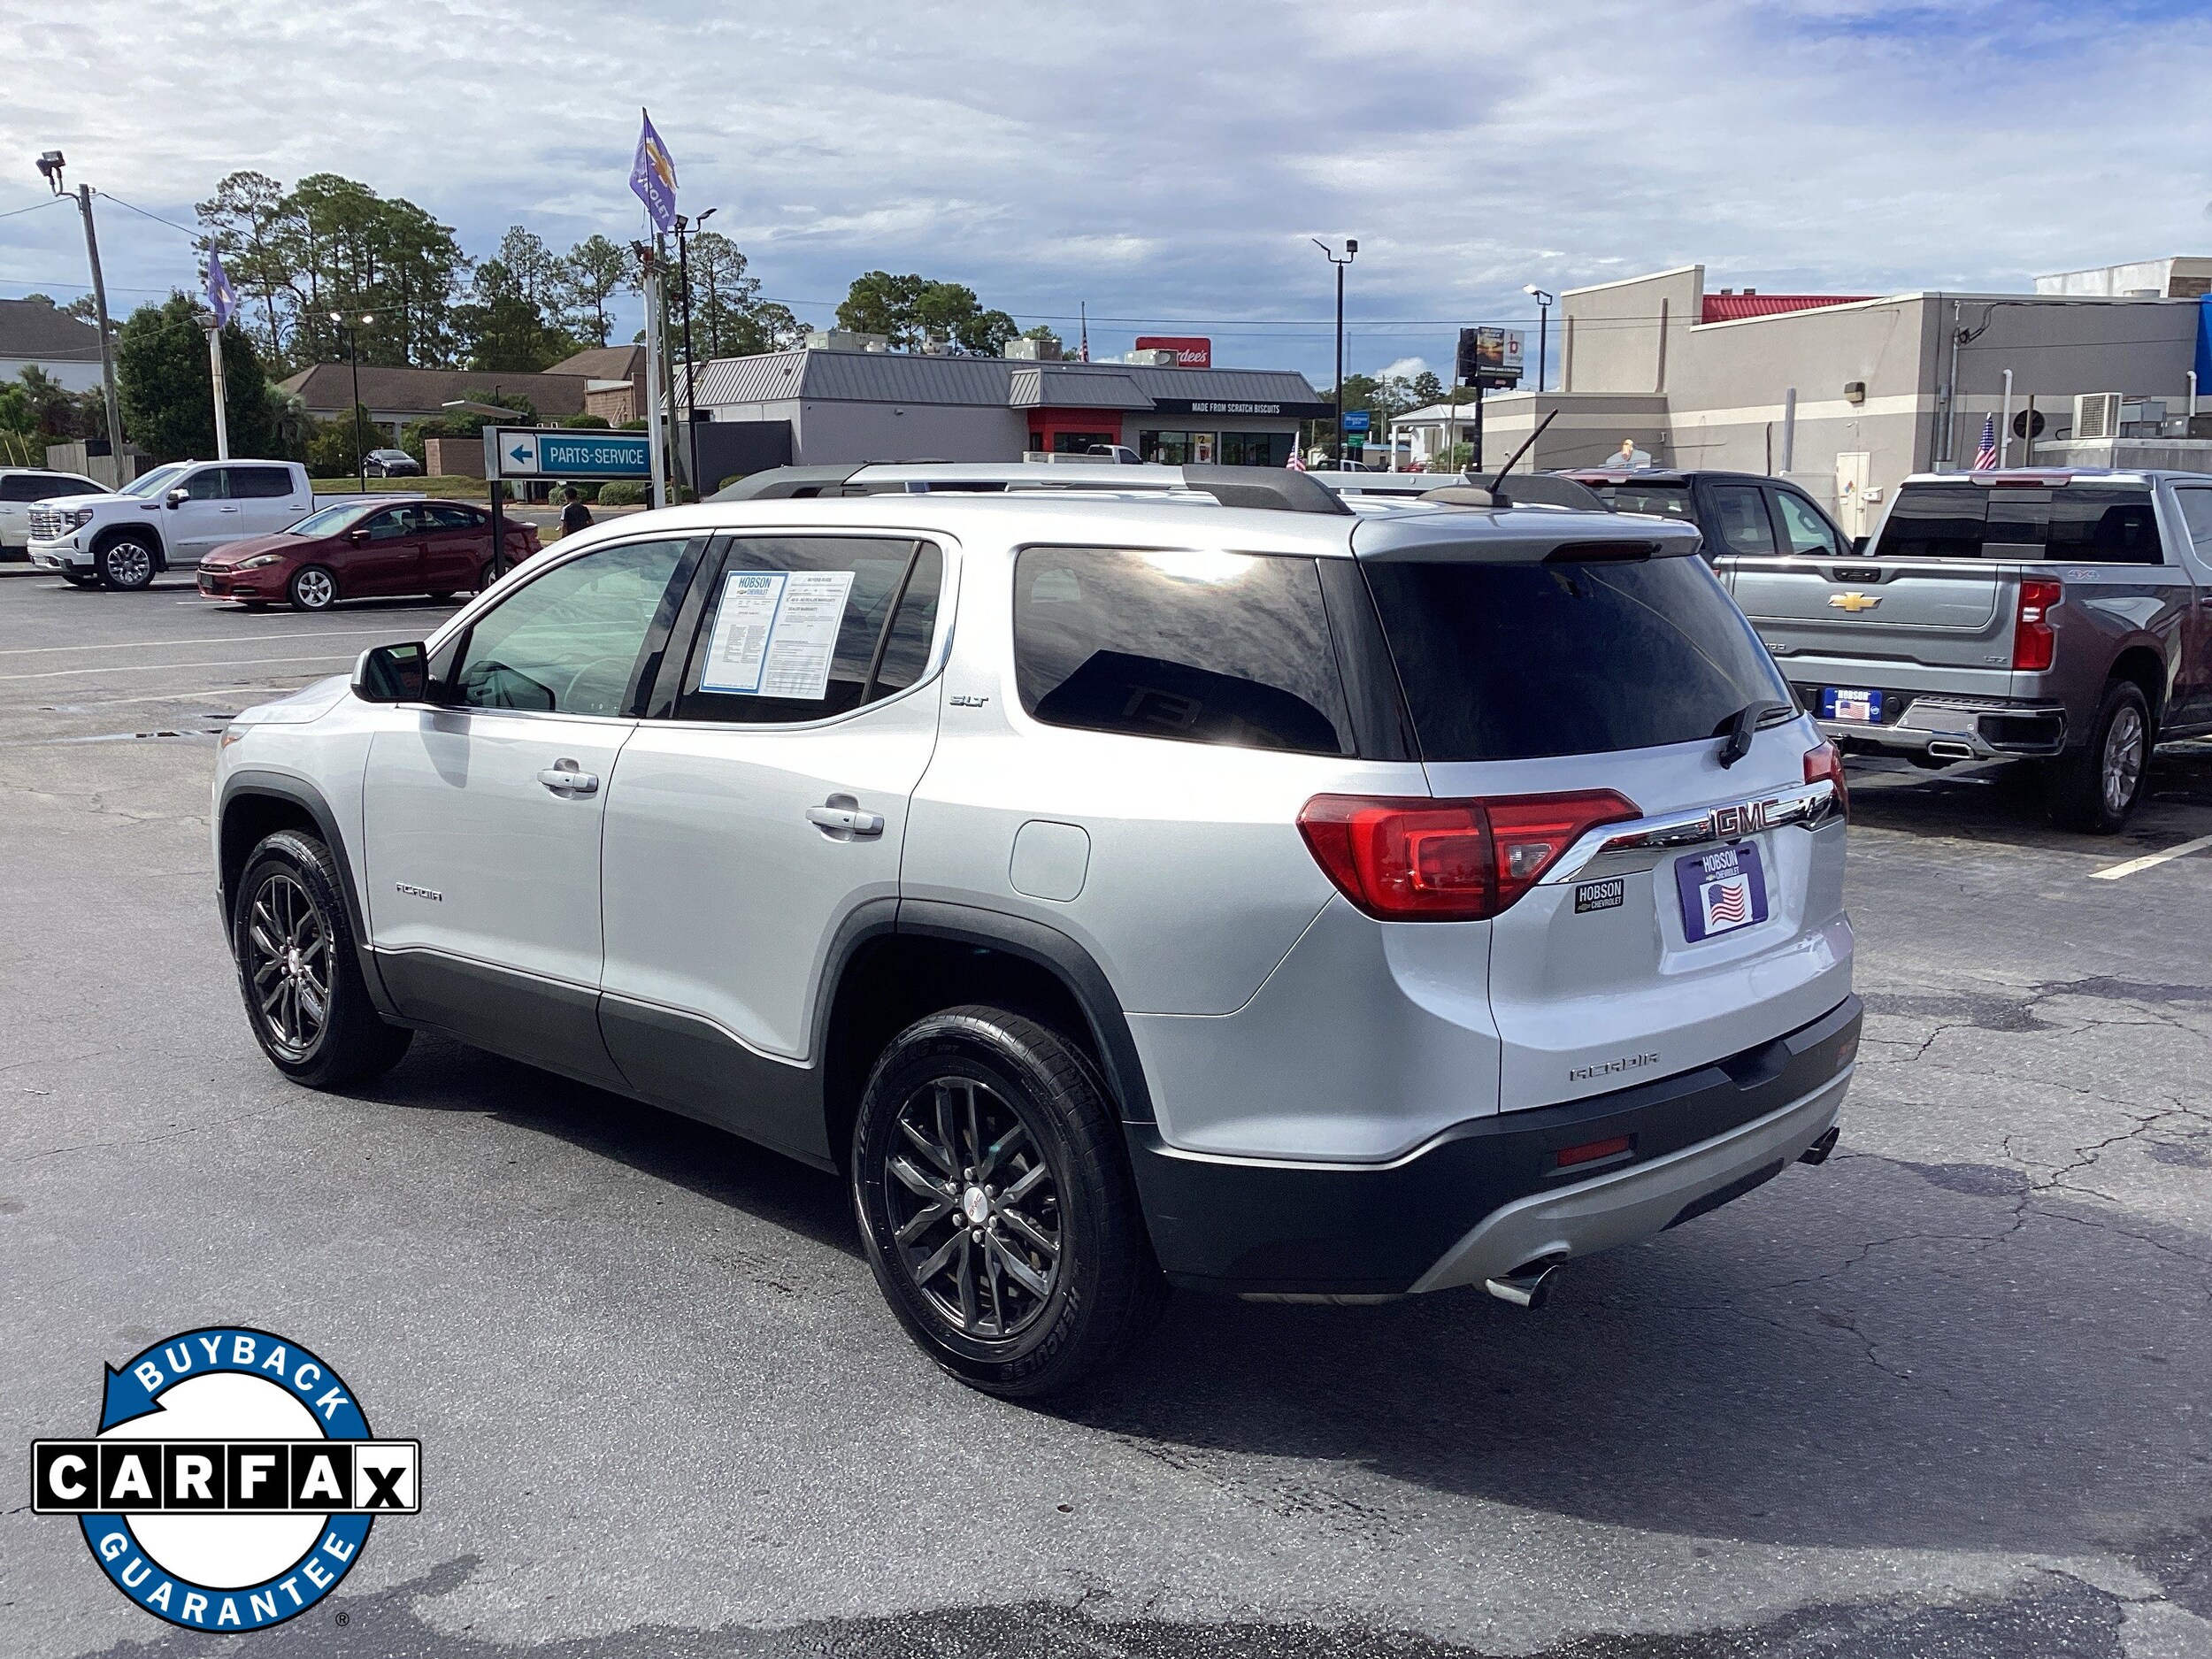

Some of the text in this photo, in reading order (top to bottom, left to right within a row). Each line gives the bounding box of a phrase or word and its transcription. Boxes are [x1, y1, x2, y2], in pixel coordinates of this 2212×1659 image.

[1192, 403, 1280, 414] MADE FROM SCRATCH BISCUITS
[550, 447, 644, 465] PARTS-SERVICE
[738, 577, 772, 588] HOBSON
[949, 695, 989, 708] SLT
[1715, 797, 1781, 838] GMC
[1702, 849, 1739, 873] HOBSON
[396, 881, 442, 902] ACADIA
[1578, 880, 1622, 902] HOBSON
[1591, 895, 1622, 910] CHEVROLET
[1570, 1049, 1661, 1081] ACADIA
[968, 1193, 983, 1217] GMC
